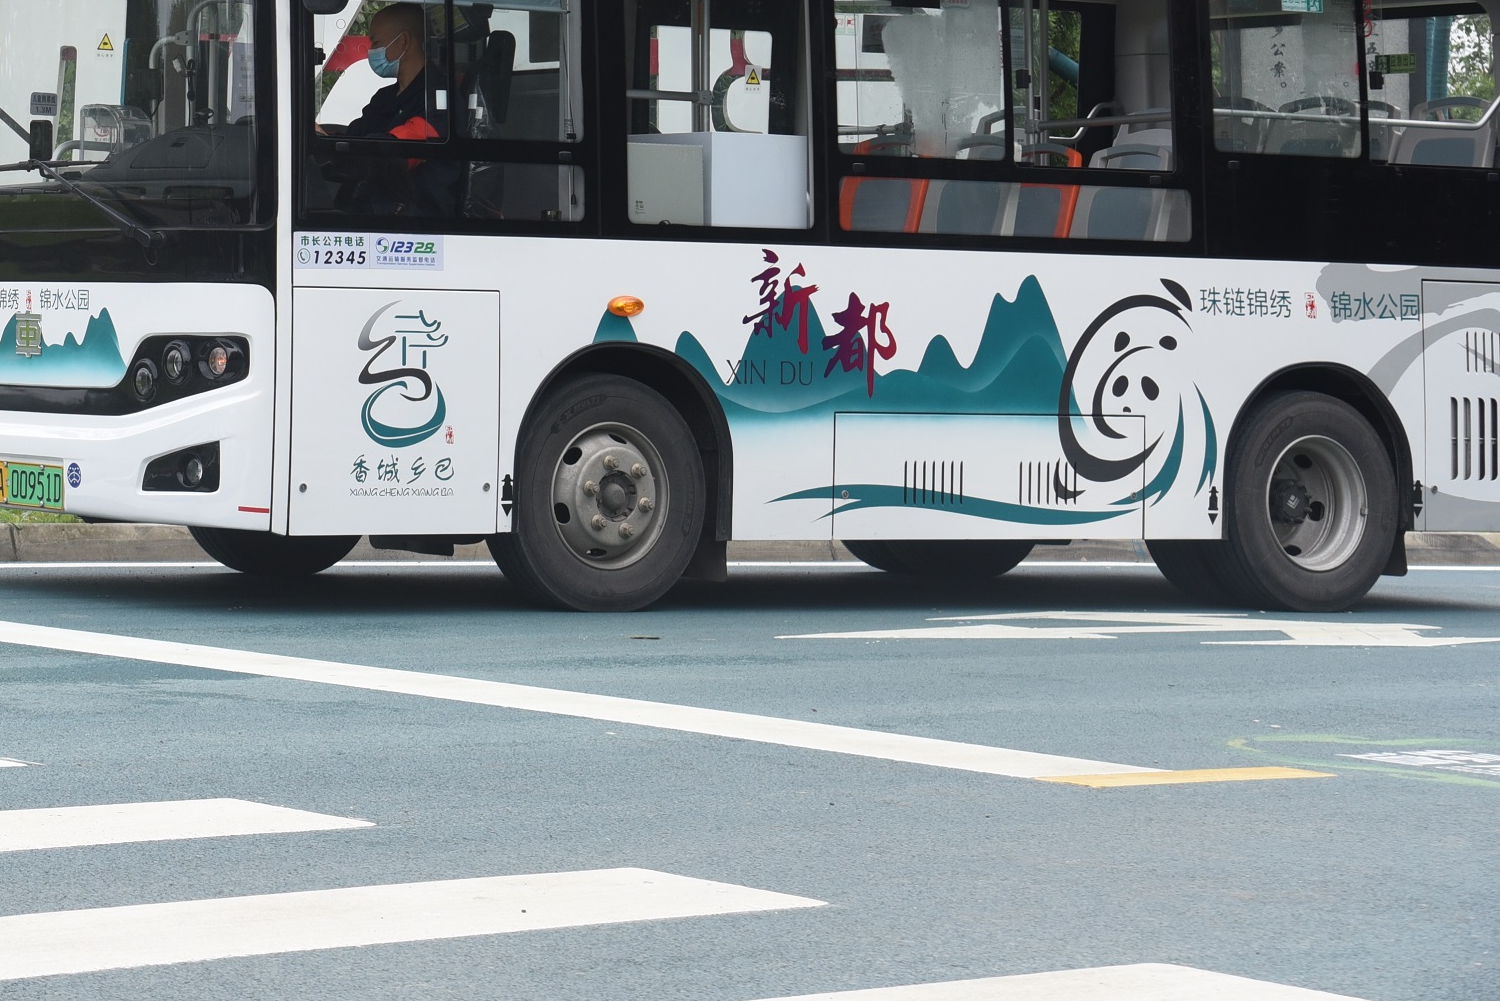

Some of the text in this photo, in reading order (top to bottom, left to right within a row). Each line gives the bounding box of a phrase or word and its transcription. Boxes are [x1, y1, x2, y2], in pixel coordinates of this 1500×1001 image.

[300, 235, 365, 247] 市长公开电话
[389, 240, 436, 254] 12328
[313, 250, 367, 265] 12345
[39, 288, 90, 311] 锦水公园
[1199, 286, 1292, 319] 珠链锦绣
[1330, 290, 1421, 322] 锦水公园
[742, 248, 897, 399] 新都
[725, 359, 814, 386] XIN DU
[350, 454, 455, 485] 香城乡巴
